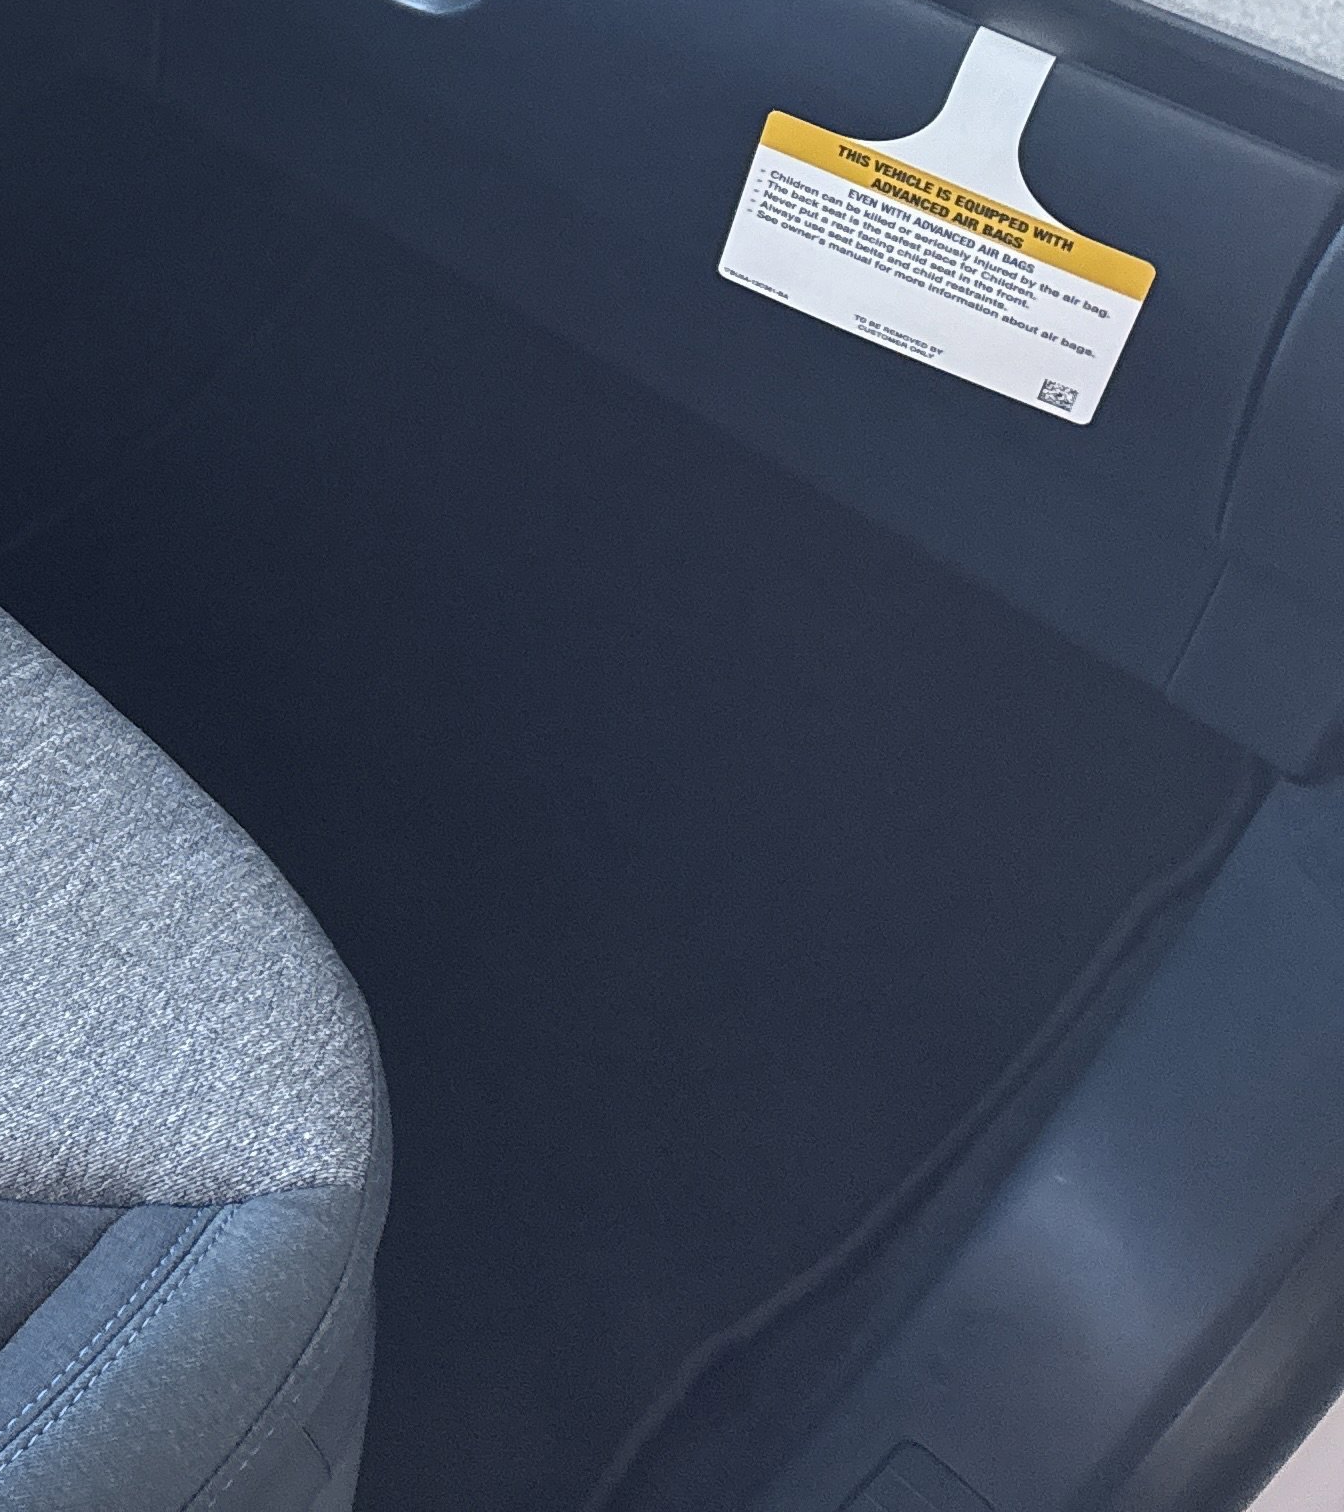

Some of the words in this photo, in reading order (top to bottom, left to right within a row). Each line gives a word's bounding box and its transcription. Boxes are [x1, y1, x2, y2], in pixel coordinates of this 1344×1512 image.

[759, 200, 802, 224] Always
[804, 220, 826, 234] use
[827, 230, 854, 246] seat
[854, 240, 885, 260] belts
[886, 256, 912, 271] and
[912, 267, 944, 284] child
[945, 280, 1008, 312] restraints.
[763, 189, 798, 210] Never
[798, 206, 819, 220] put
[820, 216, 829, 225] a
[830, 220, 856, 235] rear
[857, 230, 895, 254] facing
[896, 248, 928, 266] child
[929, 262, 957, 278] seat
[958, 272, 971, 285] in
[973, 279, 994, 294] the
[996, 288, 1030, 309] front.
[767, 179, 789, 195] The
[790, 189, 820, 209] back
[821, 205, 848, 221] seat
[848, 215, 860, 226] is
[862, 221, 882, 235] the
[884, 231, 922, 252] safest
[922, 248, 957, 267] place
[959, 261, 979, 275] for
[980, 270, 1037, 301] Children.
[770, 170, 820, 197] Children
[821, 193, 844, 208] can
[845, 201, 861, 215] be
[863, 209, 897, 230] killed
[898, 226, 913, 236] or
[914, 232, 972, 262] seriously
[973, 255, 1019, 281] injured
[1019, 275, 1038, 289] by
[1039, 283, 1060, 298] the
[1062, 294, 1081, 306] air
[1082, 300, 1110, 319] bag.
[838, 144, 872, 168] THIS
[874, 159, 935, 195] VEHICLE
[935, 186, 953, 202] IS
[954, 194, 1030, 234] EQUIPPED
[1033, 226, 1075, 253] WITH
[847, 188, 879, 209] EVEN
[880, 201, 912, 223] WITH
[912, 217, 976, 249] ADVANCED
[977, 244, 1000, 260] AIR
[1001, 253, 1036, 274] BAGS
[870, 177, 951, 218] ADVANCED
[951, 212, 980, 232] AIR
[981, 223, 1025, 249] BAGS
[756, 209, 779, 225] See
[780, 221, 826, 246] owner's
[828, 242, 873, 266] manual
[874, 260, 893, 274] for
[893, 270, 926, 288] more
[927, 283, 999, 319] information
[1001, 315, 1039, 335] about
[1040, 331, 1059, 342] air
[1060, 337, 1095, 358] bags.
